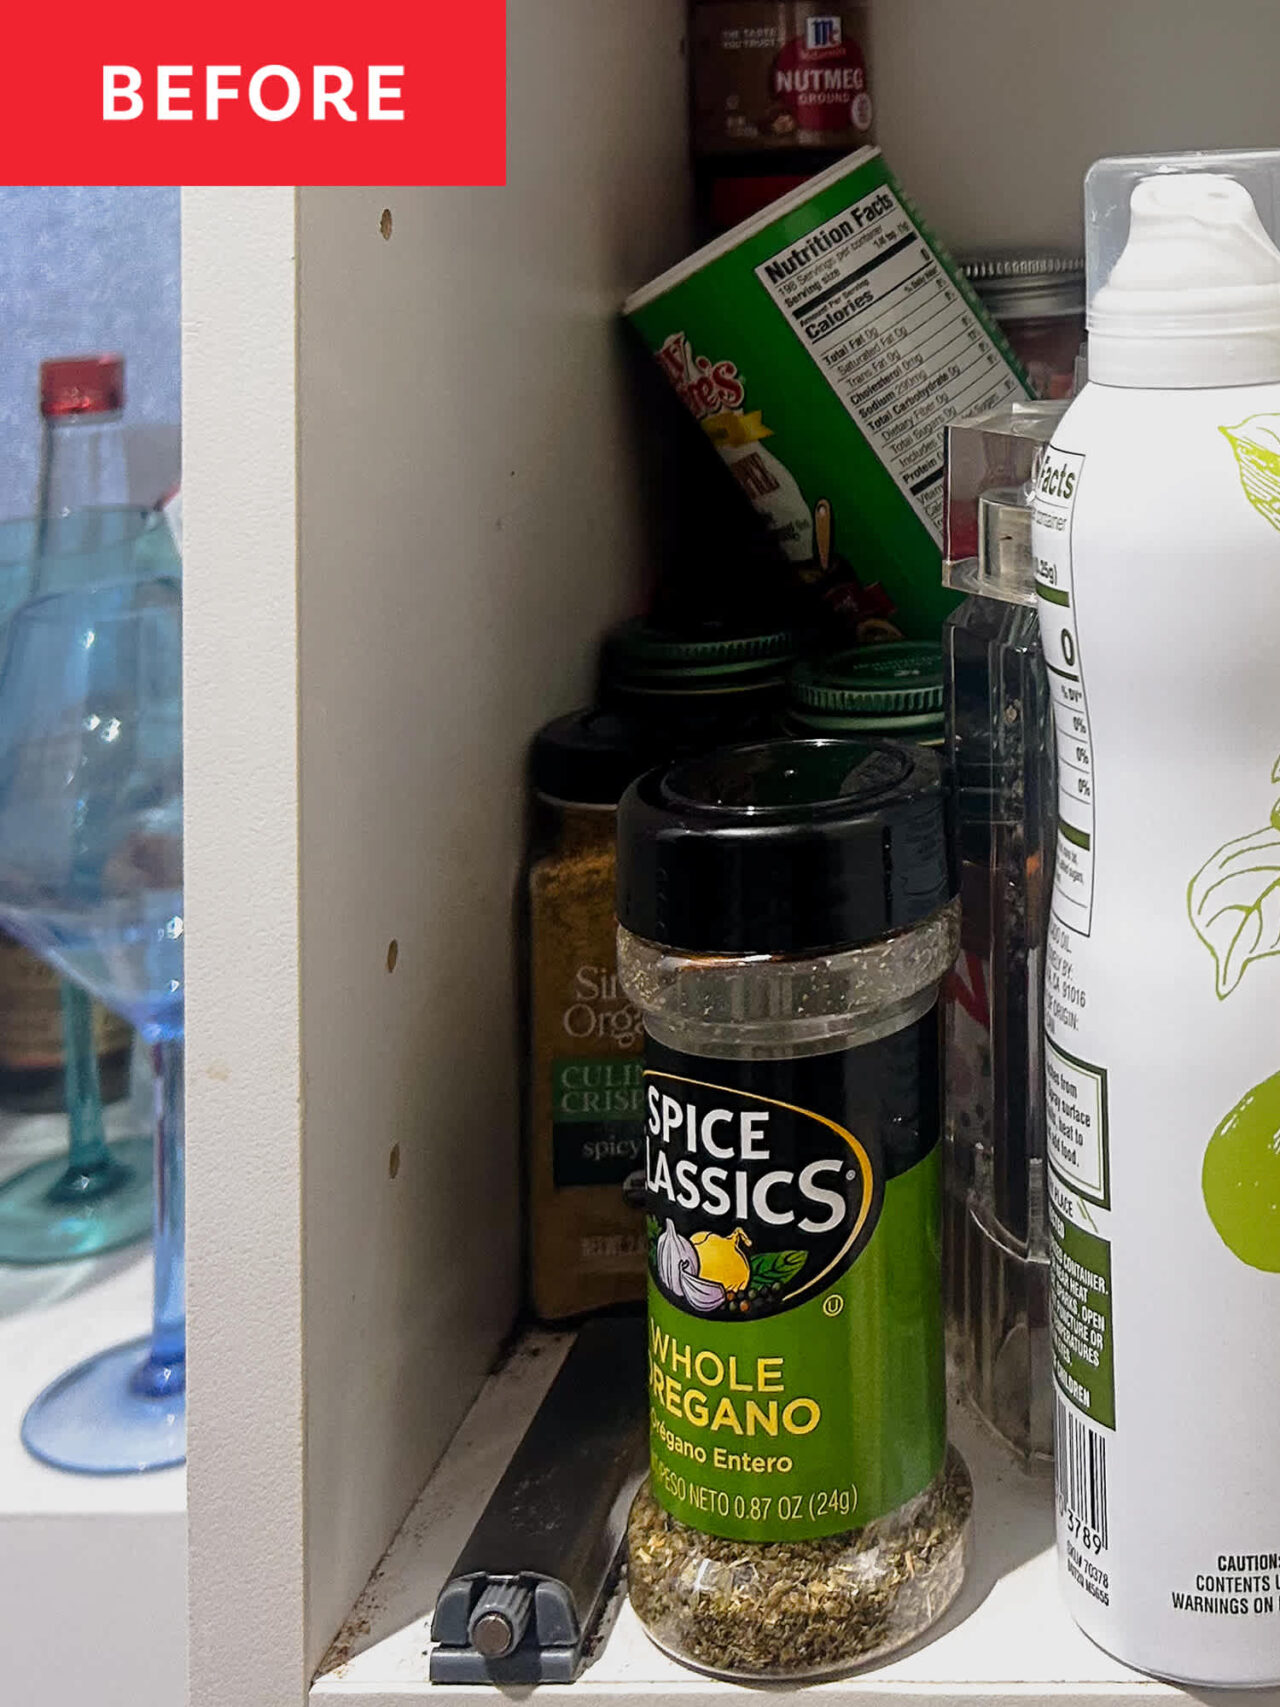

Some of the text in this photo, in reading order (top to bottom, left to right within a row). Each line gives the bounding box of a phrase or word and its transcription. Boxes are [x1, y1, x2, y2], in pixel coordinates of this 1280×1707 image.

[775, 68, 864, 92] NUTMEG
[798, 92, 850, 104] GROUND
[763, 190, 895, 284] Nutrition Facts
[835, 246, 850, 260] per
[784, 279, 822, 308] Serving
[820, 267, 840, 283] size
[803, 247, 931, 340] Calories 0
[822, 344, 849, 366] Total
[848, 334, 865, 349] Fat
[836, 342, 881, 376] Saturated
[879, 332, 895, 347] Fat
[871, 357, 887, 371] Fat
[848, 364, 904, 405] Cholesterol
[857, 389, 896, 419] Sodium
[866, 410, 893, 431] Total
[890, 372, 951, 415] Carbohydrate
[880, 414, 915, 442] Dietary
[889, 434, 914, 454] Total
[897, 436, 938, 467] Includes
[900, 456, 937, 484] Protein
[1061, 628, 1075, 667] 0
[1073, 716, 1087, 734] 0%
[1076, 747, 1089, 765] 0%
[1078, 778, 1091, 796] 0%
[1063, 981, 1086, 1008] 91016
[563, 1003, 645, 1047] Orga
[1061, 1073, 1077, 1099] from
[561, 1089, 645, 1112] CRISP
[1062, 1100, 1090, 1128] surface
[648, 1085, 770, 1160] SPICE
[583, 1135, 640, 1161] spicy
[1075, 1128, 1083, 1146] to
[645, 1136, 847, 1234] LASSICS
[1063, 1253, 1109, 1295] CONTAINER.
[1070, 1277, 1088, 1303] HEAT
[1081, 1305, 1105, 1332] OPEN
[1090, 1329, 1104, 1351] OR
[650, 1317, 785, 1392] WHOLE
[713, 1447, 793, 1473] Entero
[689, 1482, 729, 1517] NETO
[735, 1496, 771, 1521] 0.87
[778, 1495, 803, 1520] OZ
[809, 1484, 858, 1521] (24g)
[1067, 1508, 1102, 1555] 3789
[1084, 1558, 1109, 1588] 70378
[1196, 1574, 1270, 1593] CONTENTS
[1172, 1592, 1249, 1615] WARNINGS
[1254, 1596, 1274, 1614] ON
